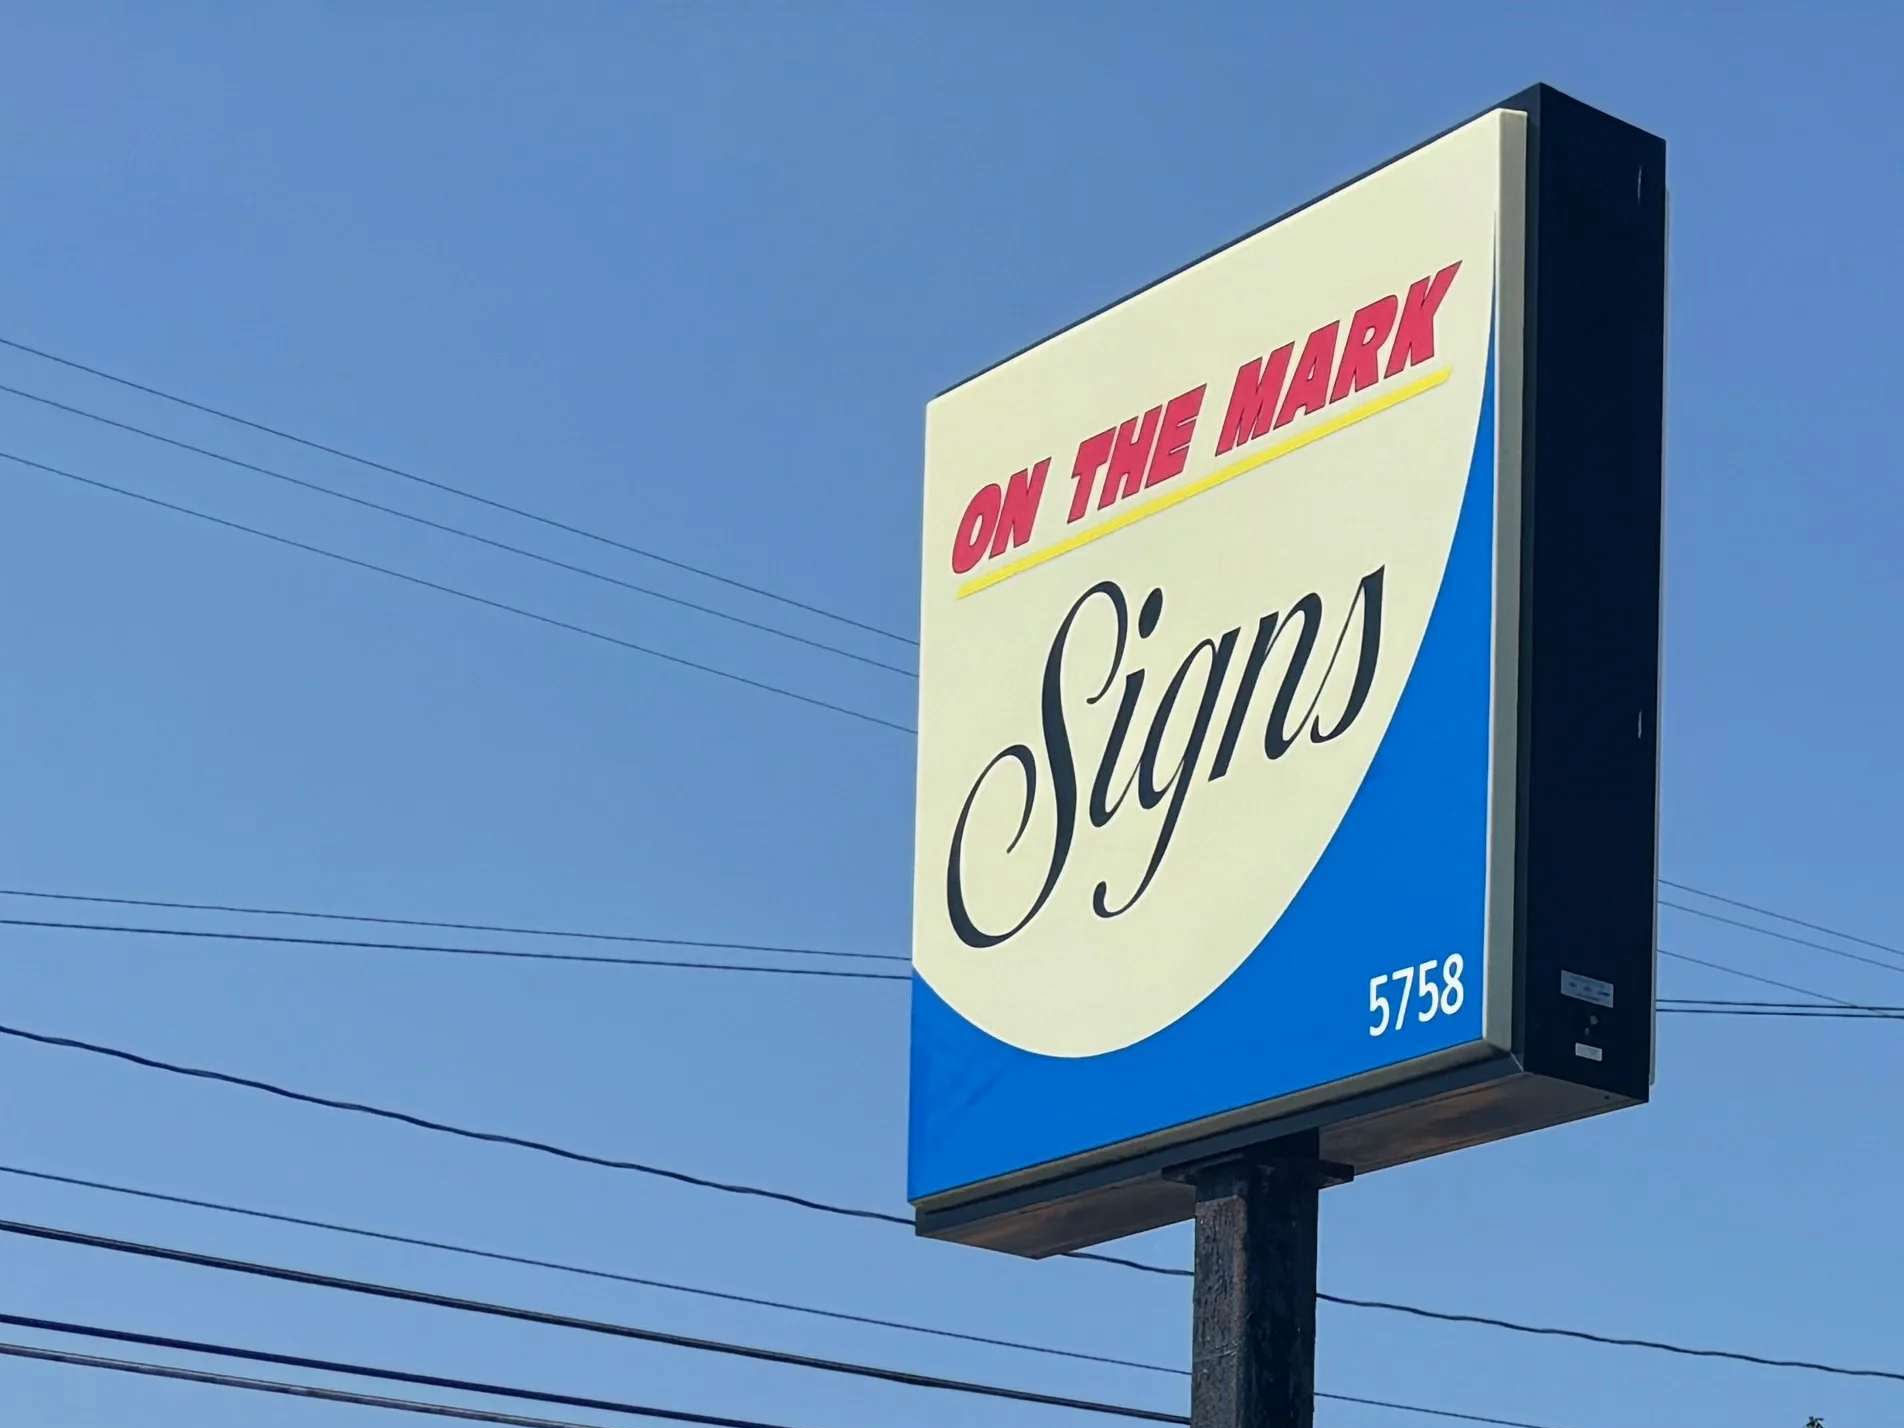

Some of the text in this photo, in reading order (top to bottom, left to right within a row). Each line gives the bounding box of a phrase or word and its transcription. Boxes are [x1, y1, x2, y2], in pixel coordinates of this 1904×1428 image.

[951, 259, 1463, 575] ON THE MARK
[946, 563, 1386, 949] Signs
[1368, 953, 1465, 1037] 5758
